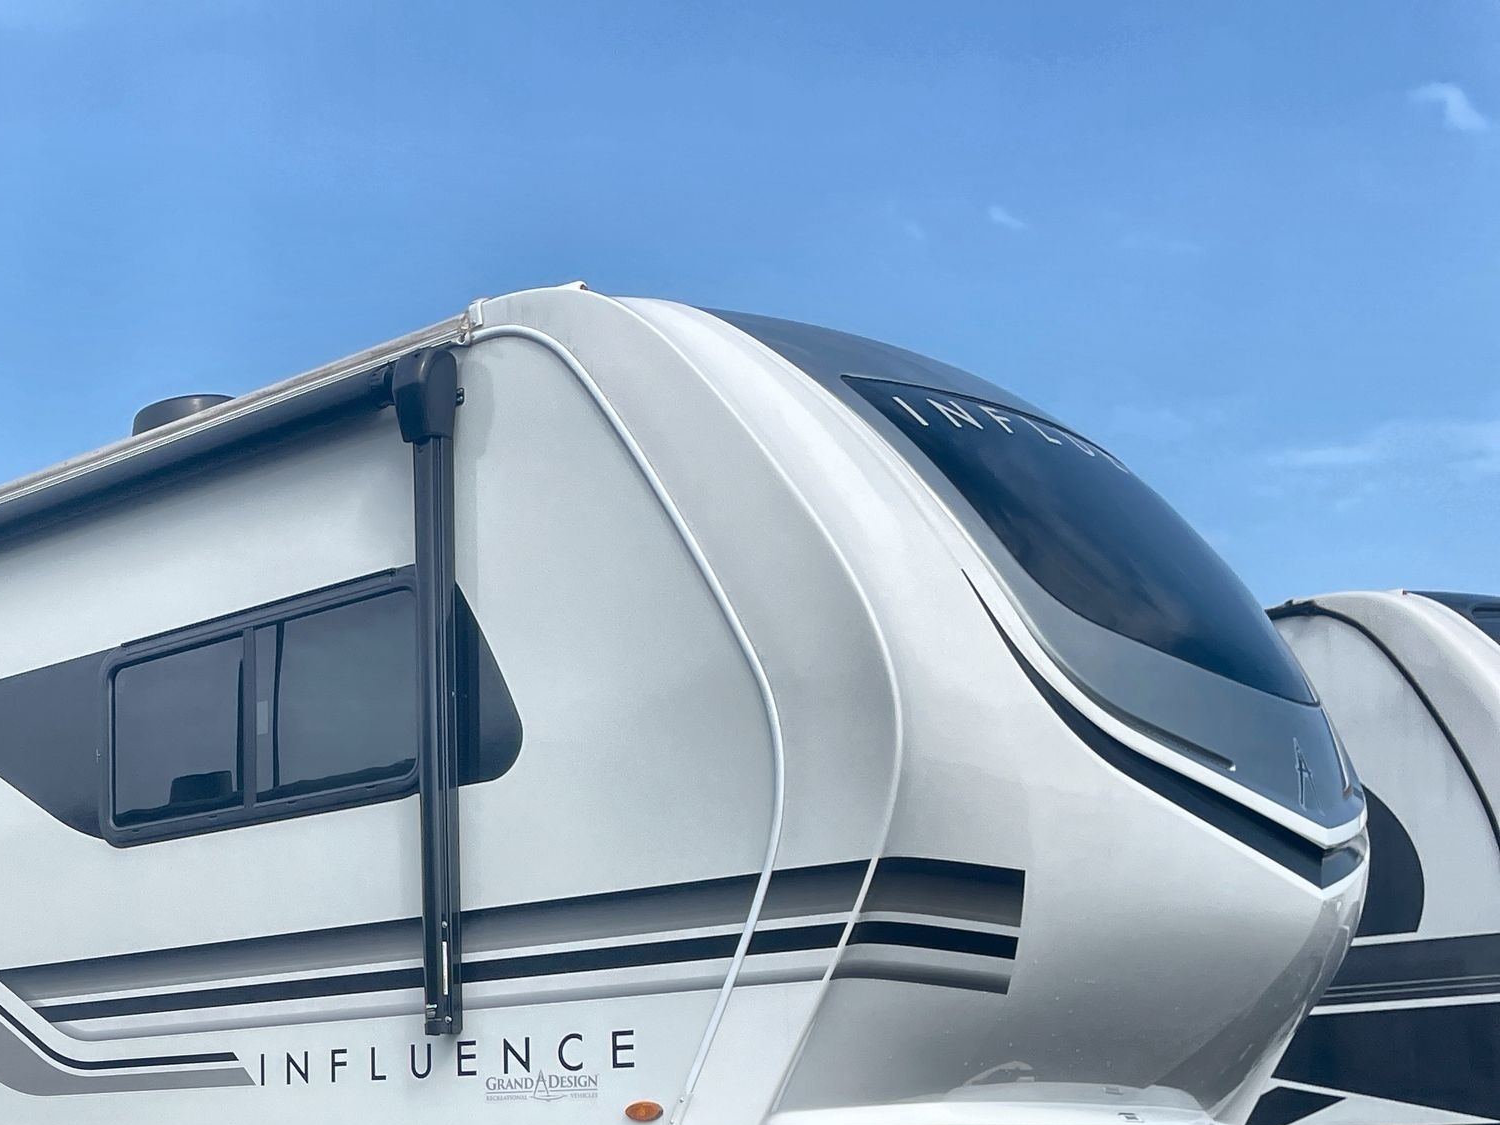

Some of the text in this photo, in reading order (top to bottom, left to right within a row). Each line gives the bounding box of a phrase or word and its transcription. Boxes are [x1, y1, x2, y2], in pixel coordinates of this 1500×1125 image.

[260, 1029, 635, 1086] INFLUENCE
[486, 1073, 598, 1091] GRAND DESIGN
